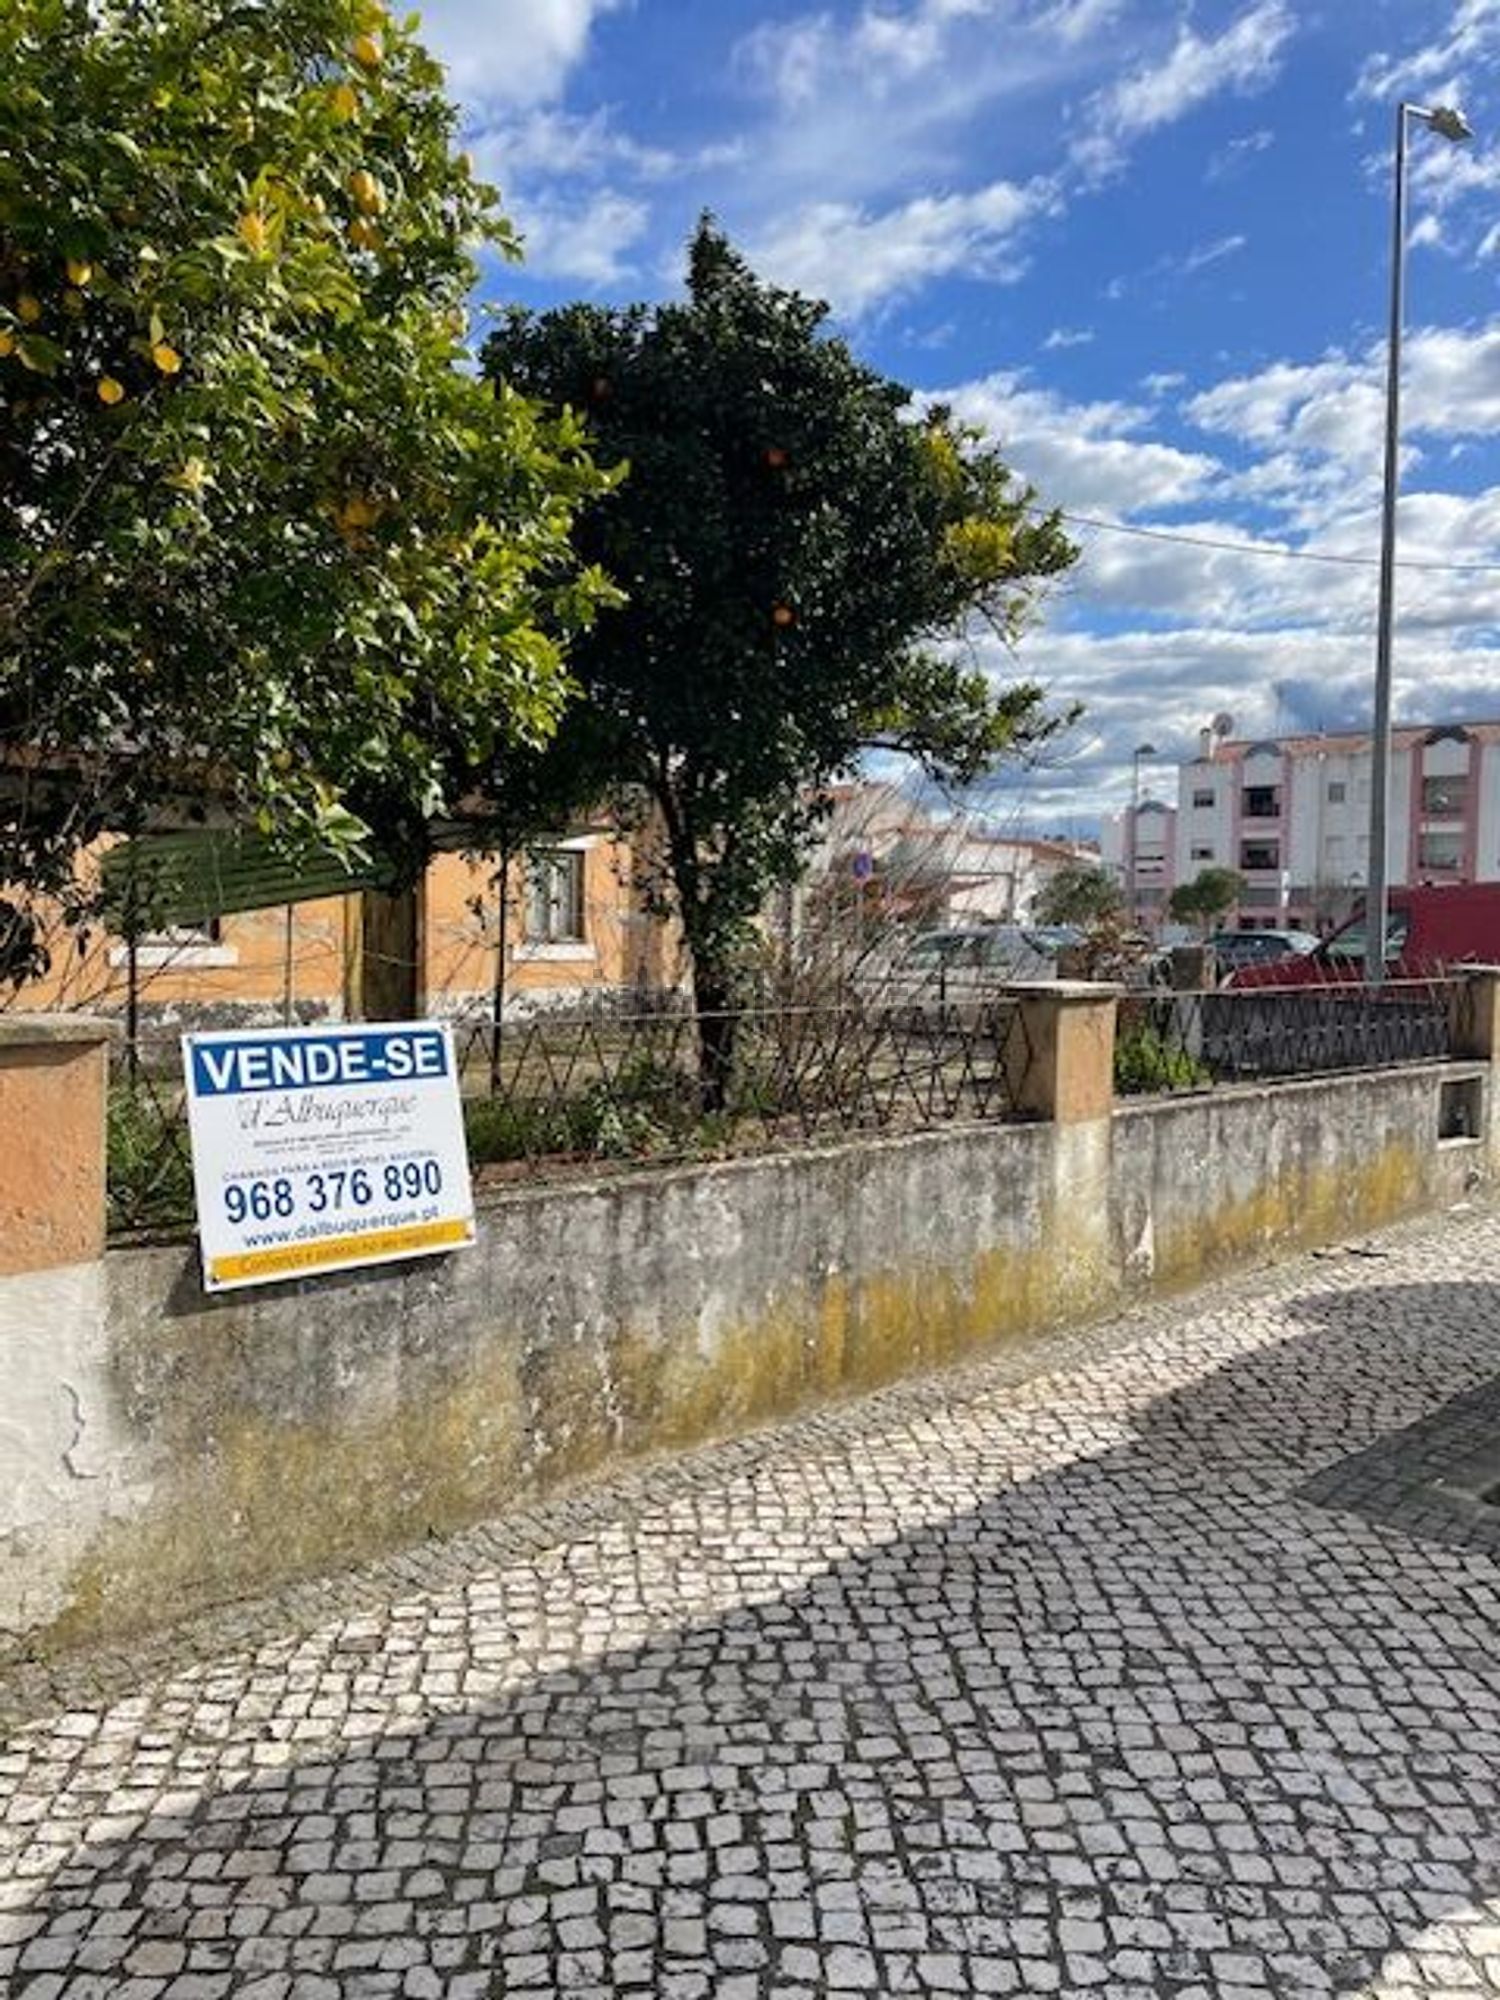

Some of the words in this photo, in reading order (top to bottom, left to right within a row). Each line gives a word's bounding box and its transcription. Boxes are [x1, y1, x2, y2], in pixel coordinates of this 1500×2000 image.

[200, 1036, 442, 1090] VENDE-SE
[224, 1178, 295, 1223] 968
[306, 1168, 373, 1212] 376
[384, 1159, 442, 1201] 890
[244, 1205, 439, 1247] www.dalbuquerque.pt
